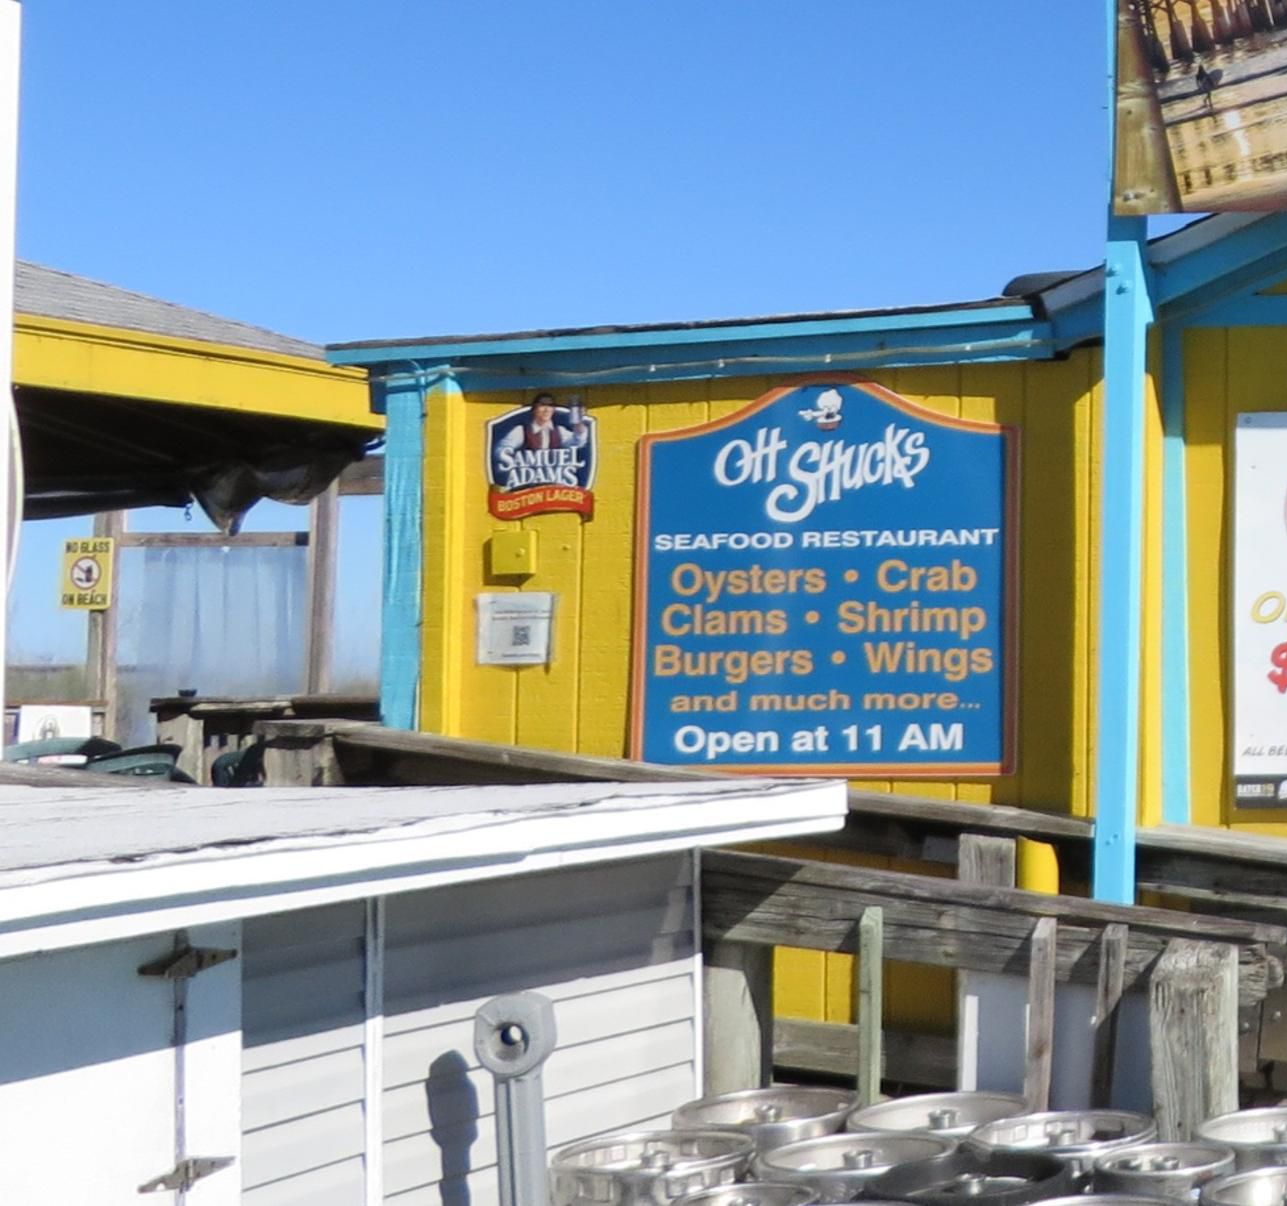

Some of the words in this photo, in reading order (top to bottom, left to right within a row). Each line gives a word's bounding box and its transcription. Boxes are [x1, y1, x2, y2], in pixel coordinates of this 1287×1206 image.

[498, 446, 586, 471] SAMUEL
[506, 466, 579, 488] ADAMS
[497, 492, 543, 512] BOSTON
[546, 490, 583, 504] LAGER
[66, 542, 79, 553] NO
[80, 541, 110, 553] GLASS
[655, 531, 793, 551] SEAFOOD
[802, 528, 999, 549] RESTAURANT
[671, 562, 827, 603] Oysters
[877, 559, 978, 592] Crab
[63, 594, 75, 606] ON
[77, 593, 108, 605] BEACH
[661, 603, 788, 636] Clams
[837, 600, 987, 640] Shrimp
[653, 644, 814, 684] Burgers
[862, 641, 994, 681] Wings
[670, 691, 738, 713] and
[750, 690, 850, 711] much
[862, 691, 981, 711] more...
[673, 724, 779, 760] Open
[791, 725, 829, 752] at
[842, 724, 882, 751] 11
[897, 723, 964, 751] AM
[1242, 746, 1265, 756] ALL
